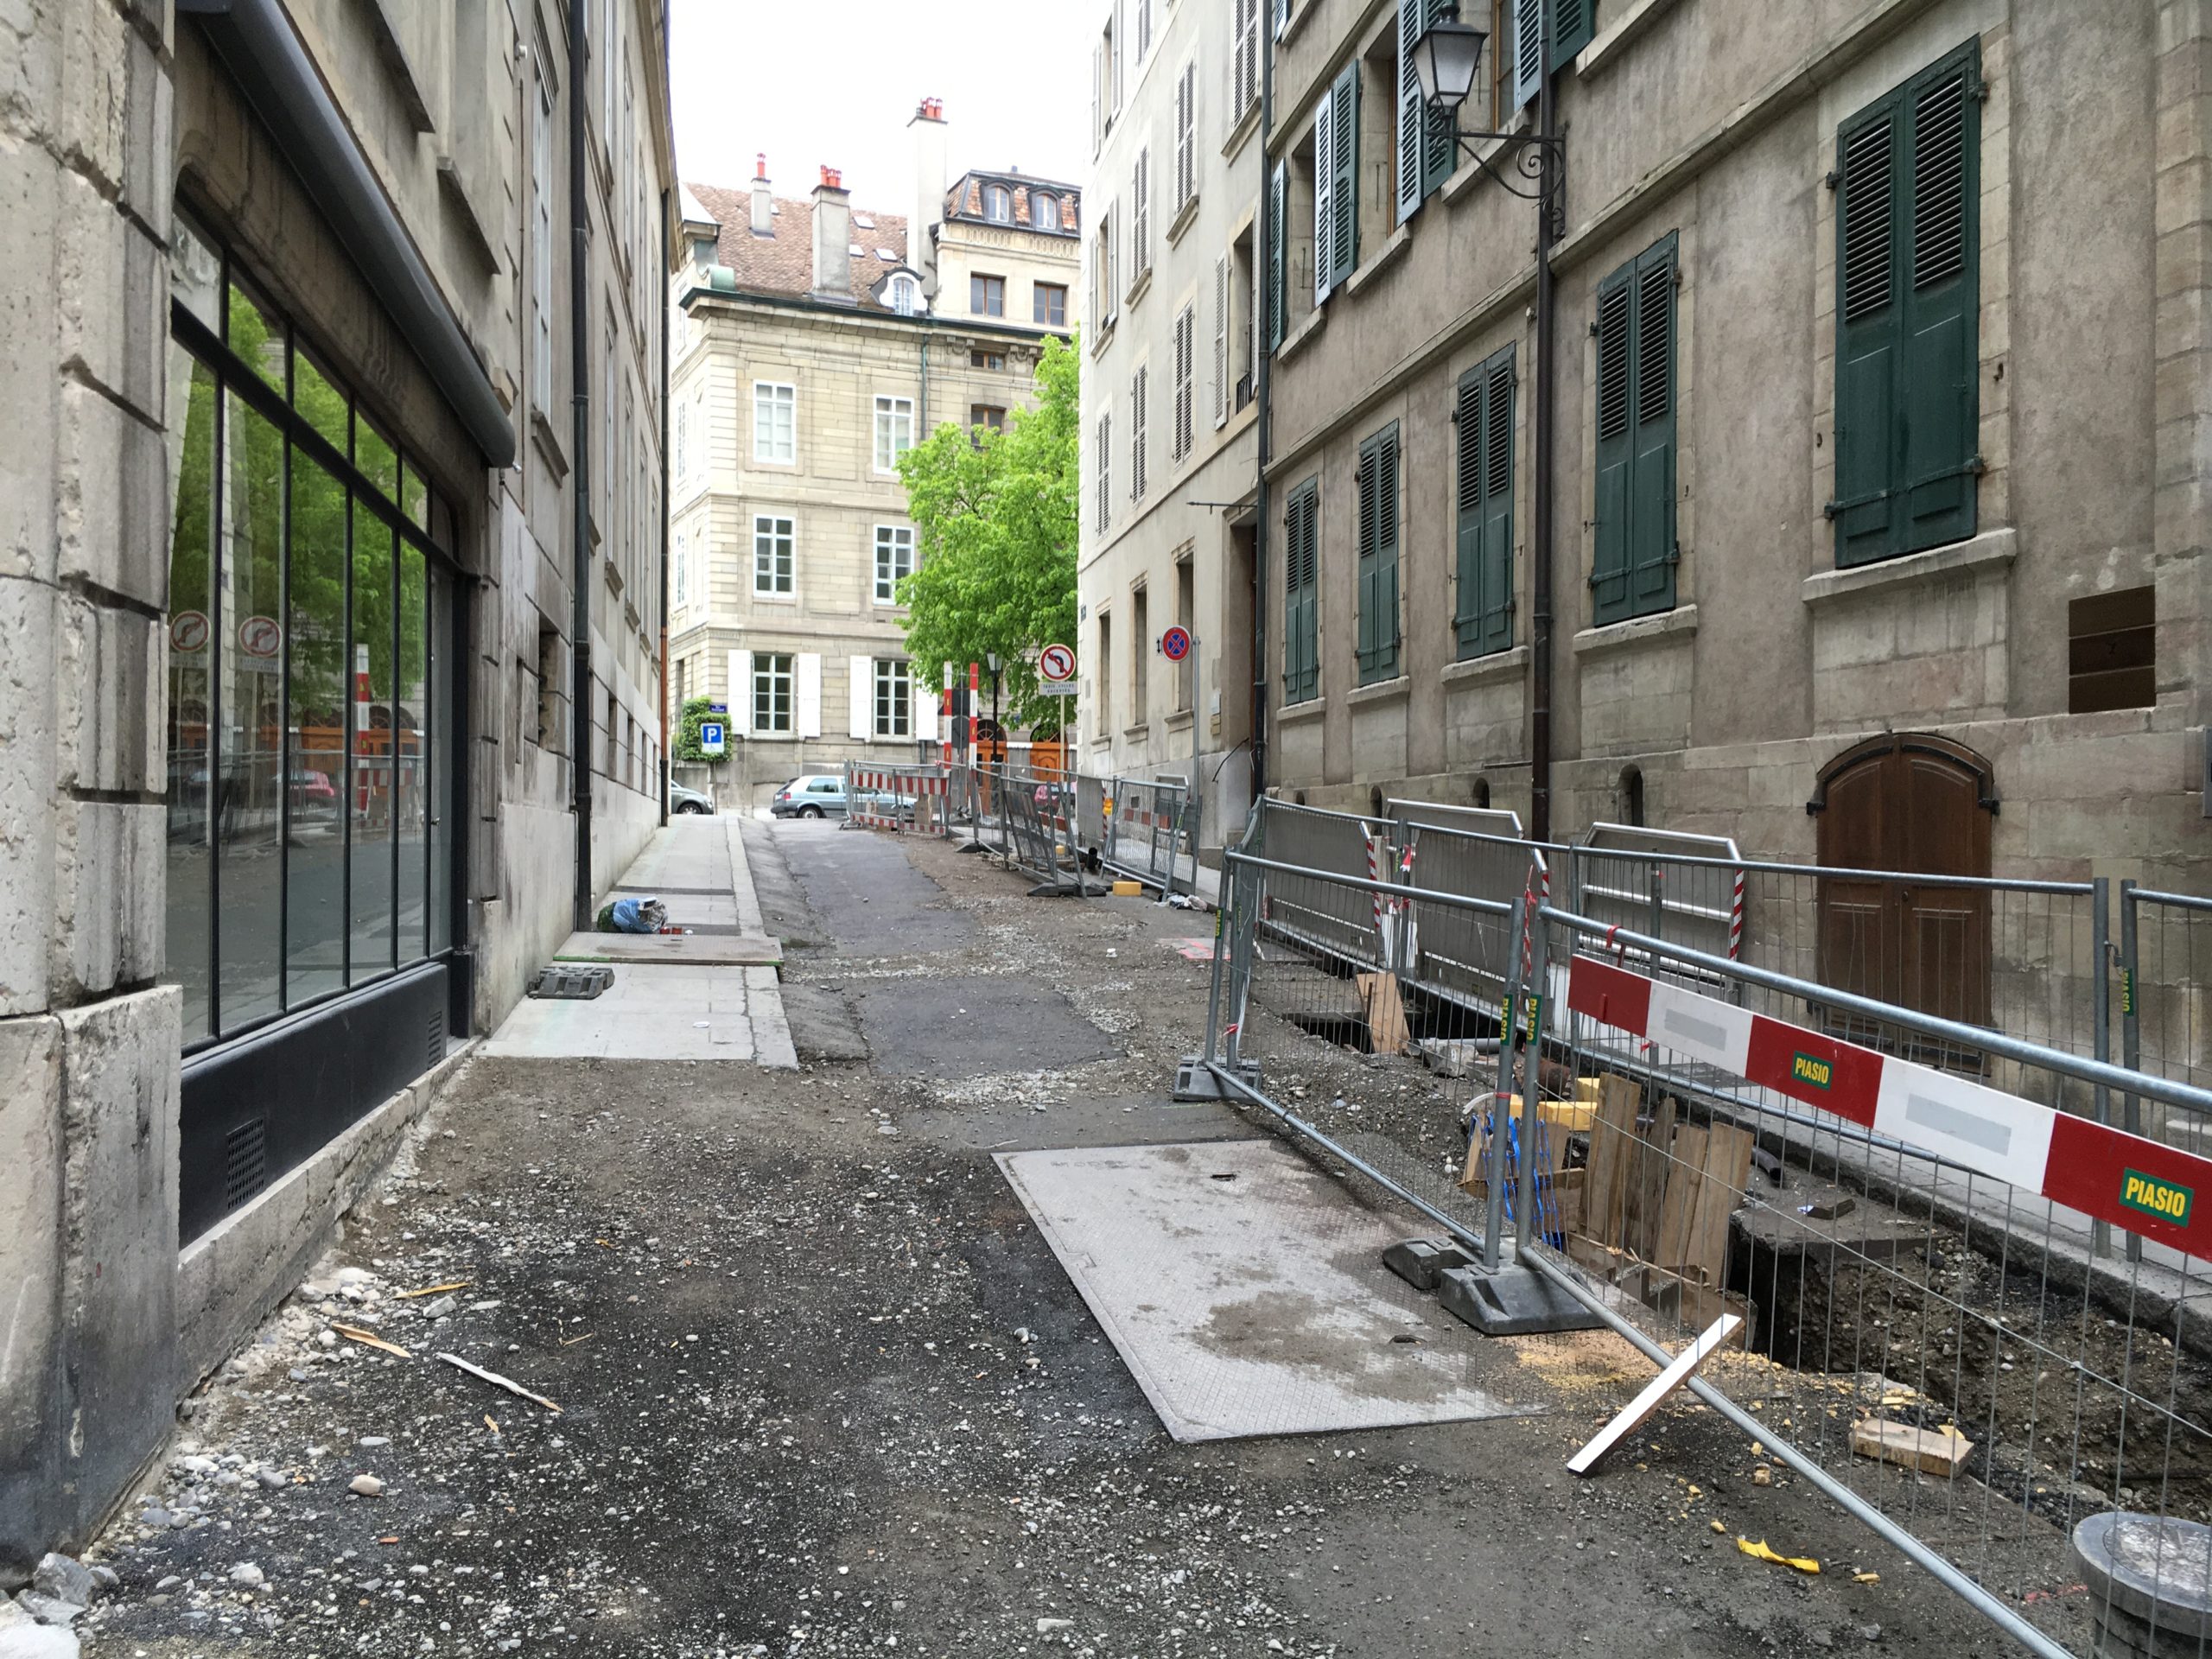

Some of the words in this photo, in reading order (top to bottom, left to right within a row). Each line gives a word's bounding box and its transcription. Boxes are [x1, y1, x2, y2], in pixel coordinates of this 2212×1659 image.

[707, 727, 718, 743] P
[1500, 997, 1510, 1041] PIASIO
[1527, 997, 1538, 1041] PIASIO
[1795, 1057, 1829, 1084] PIASIO
[2126, 1176, 2186, 1217] PIASIO
